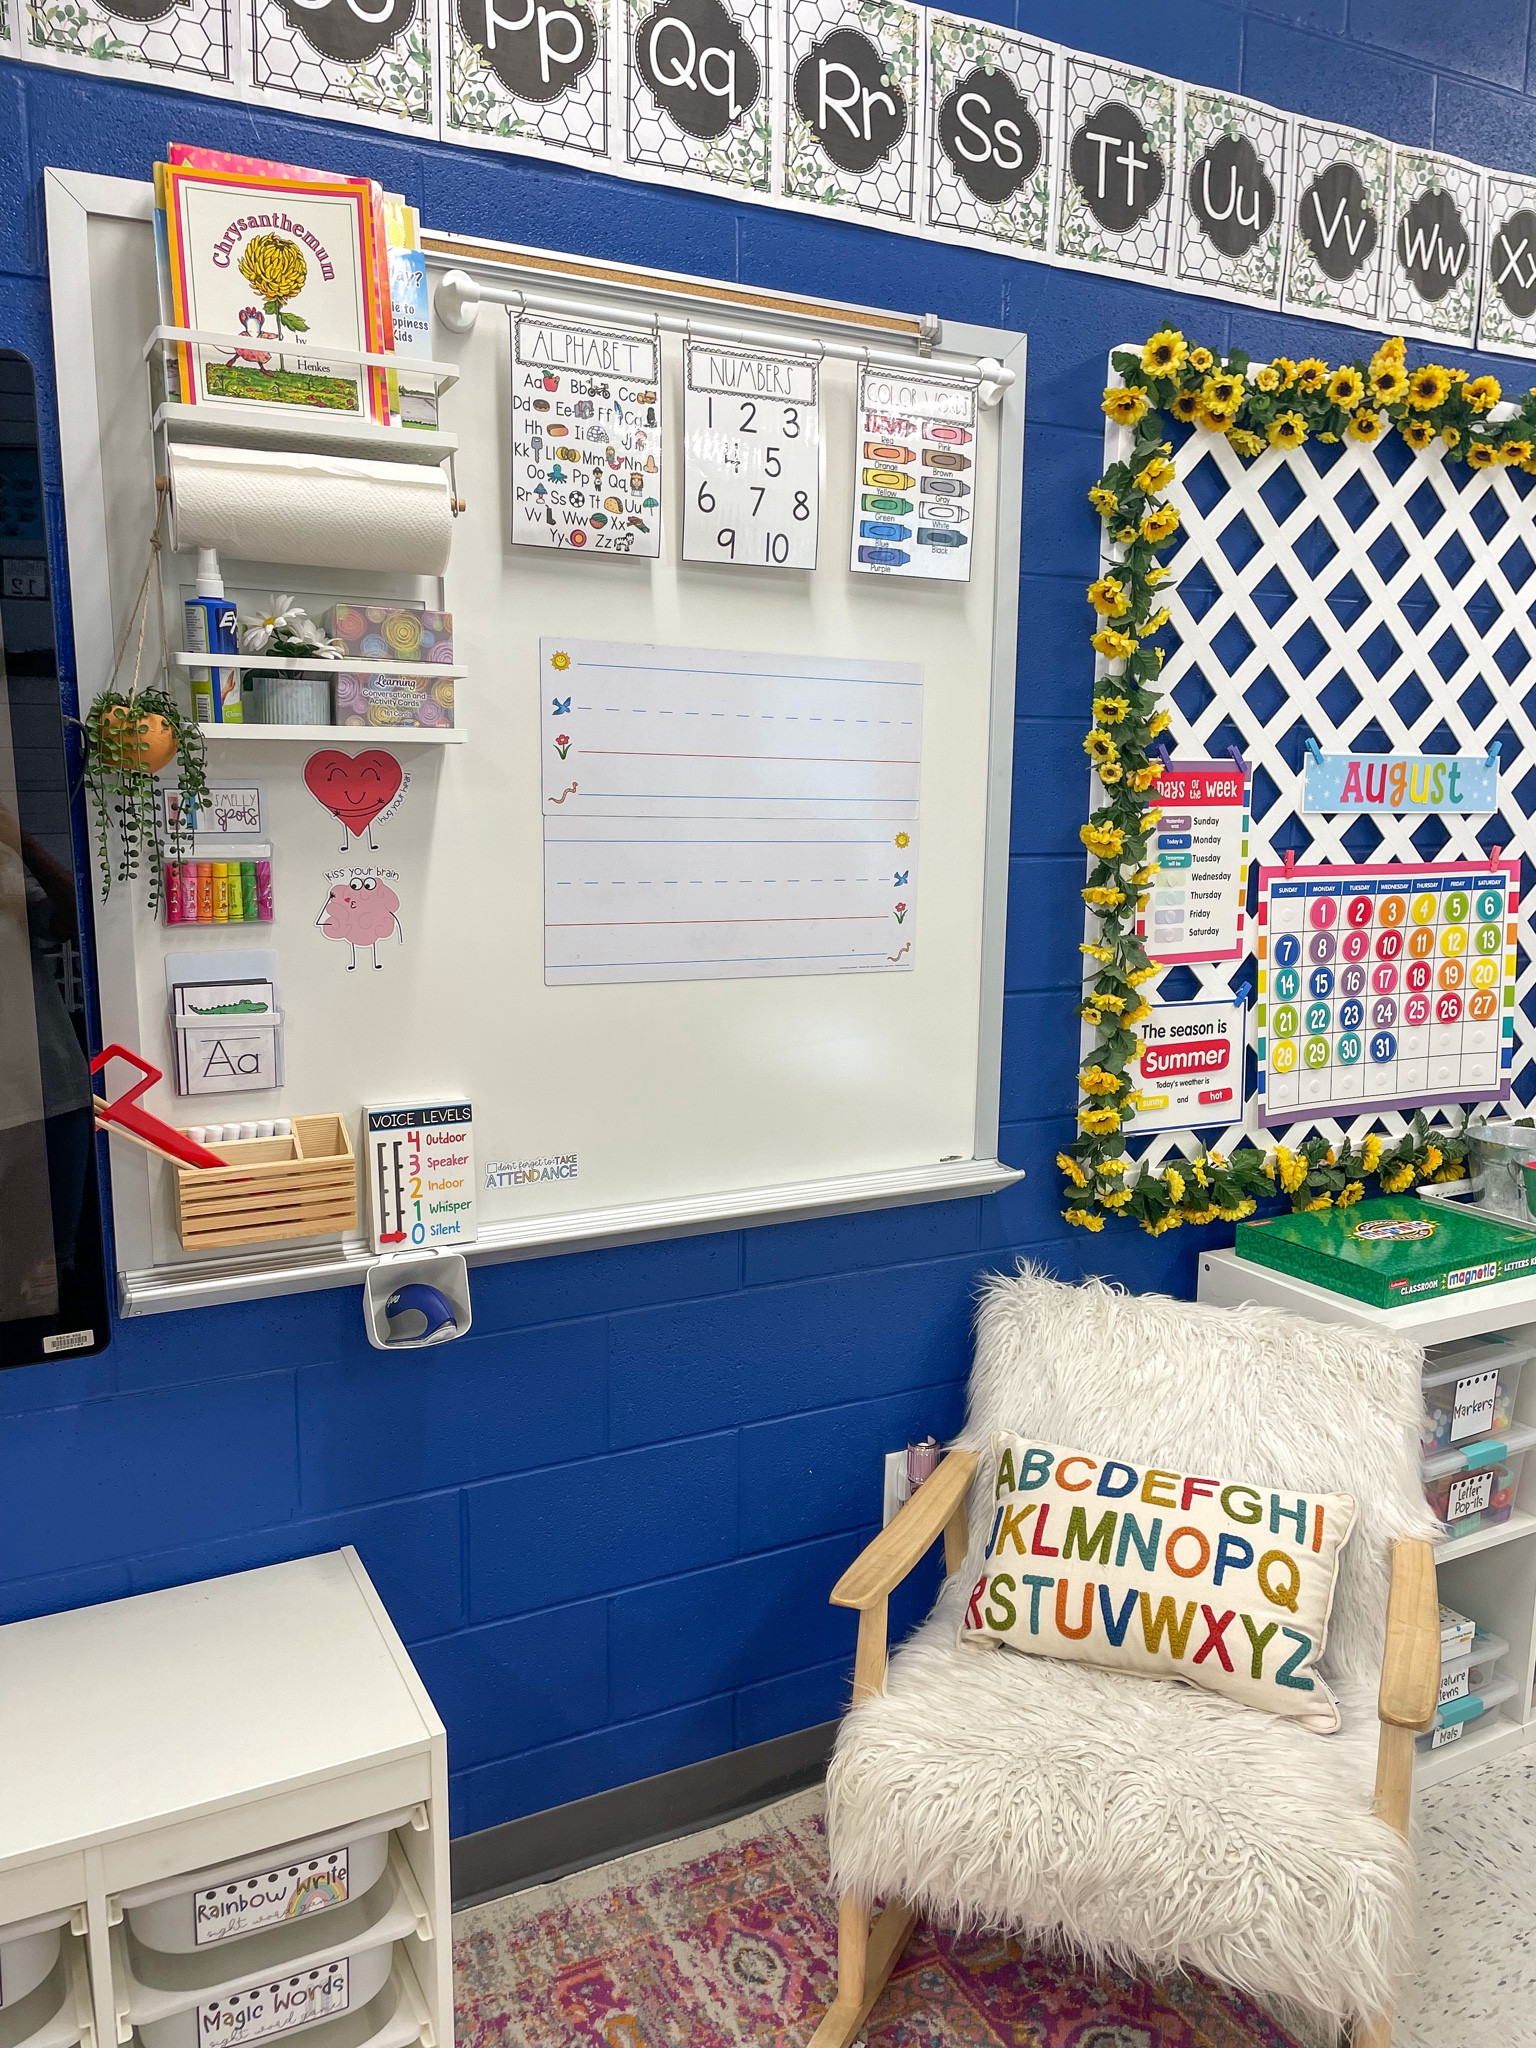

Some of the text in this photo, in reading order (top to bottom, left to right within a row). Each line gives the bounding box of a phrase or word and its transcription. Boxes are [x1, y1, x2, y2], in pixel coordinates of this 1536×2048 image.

[648, 17, 745, 119] Qq
[816, 58, 897, 143] Rr
[953, 92, 1024, 171] Ss
[1084, 132, 1149, 207] Tt
[1202, 159, 1261, 232] Uu
[1310, 191, 1368, 257] Vv
[212, 212, 335, 282] Chrysanthemum
[1402, 218, 1467, 278] Ww
[404, 304, 415, 315] to
[532, 330, 639, 373] ALPHABET
[297, 359, 331, 373] Henkes
[710, 356, 793, 394] NUMBERS
[524, 374, 636, 402] Aa Bb Cc
[867, 383, 916, 407] COLOR
[514, 396, 572, 416] Dd Ee
[740, 402, 800, 438] 2 3
[938, 443, 951, 451] Pink
[765, 447, 781, 477] 5
[874, 462, 898, 471] Orange
[573, 469, 589, 487] Pp
[698, 481, 810, 521] 6 7 8
[877, 488, 897, 497] Yellow
[875, 513, 895, 522] Green
[932, 521, 949, 529] White
[717, 528, 789, 563] 9 10
[875, 539, 889, 548] Blue
[932, 546, 948, 555] Black
[870, 564, 891, 573] Purple
[375, 675, 416, 689] Learning
[363, 690, 412, 699] Conversation
[370, 699, 396, 707] Activity
[1189, 789, 1201, 799] the
[1339, 761, 1464, 807] August
[215, 794, 256, 806] SMELLY
[377, 772, 411, 823] hug your heart
[215, 807, 258, 832] spots
[1193, 817, 1220, 827] Sunday
[1192, 835, 1221, 845] Monday
[1192, 854, 1221, 864] Tuesday
[325, 866, 400, 881] kiss your brain
[1191, 872, 1231, 882] Wednesday
[1190, 891, 1222, 900] Thursday
[1279, 886, 1298, 894] SUNDAY
[1380, 883, 1409, 891] WEDNESDAY
[1416, 881, 1439, 889] THURSDAY
[1450, 880, 1466, 888] FRIDAY
[1477, 879, 1502, 887] SATURDAY
[1189, 910, 1211, 920] Friday
[1320, 896, 1494, 923] 1 2 3 4 5 6
[1189, 927, 1220, 937] Saturday
[1283, 930, 1495, 961] 7 8 9 10 11 12 13
[1281, 965, 1492, 994] 14 15 16 17 18 19 20
[1279, 996, 1492, 1031] 21 22 23 24 25 26 27
[1141, 1019, 1227, 1039] The season is
[204, 1040, 260, 1077] Aa
[1145, 1048, 1227, 1073] Summer
[1277, 1038, 1390, 1066] 28 29 30 31
[1156, 1078, 1204, 1089] Today's weather
[1143, 1090, 1223, 1107] sunny and hot
[371, 1107, 471, 1128] VOICE LEVELS
[407, 1131, 467, 1152] 4 Outdoor
[409, 1154, 469, 1176] 3 Speaker
[518, 1159, 542, 1170] forget
[555, 1154, 577, 1165] TAKE
[487, 1164, 577, 1188] ATTENDANCE
[409, 1177, 465, 1199] 2 Indoor
[413, 1199, 473, 1222] 1 Whisper
[411, 1221, 461, 1245] 0 Silent
[1400, 1280, 1438, 1295] CLASSROOM
[1449, 1264, 1495, 1285] magnetic
[1504, 1259, 1529, 1271] LETTERS
[1454, 1397, 1494, 1420] Markers
[1458, 1485, 1482, 1501] Letter
[1441, 1671, 1465, 1688] ature
[1440, 1686, 1459, 1701] tems
[1440, 1728, 1458, 1744] Mats
[198, 1866, 346, 1923] Rainbow Write
[207, 1917, 247, 1939] sight
[252, 1903, 296, 1925] word
[204, 1975, 344, 2033] Magic Words
[210, 2029, 251, 2048] sight
[254, 2011, 297, 2035] word
